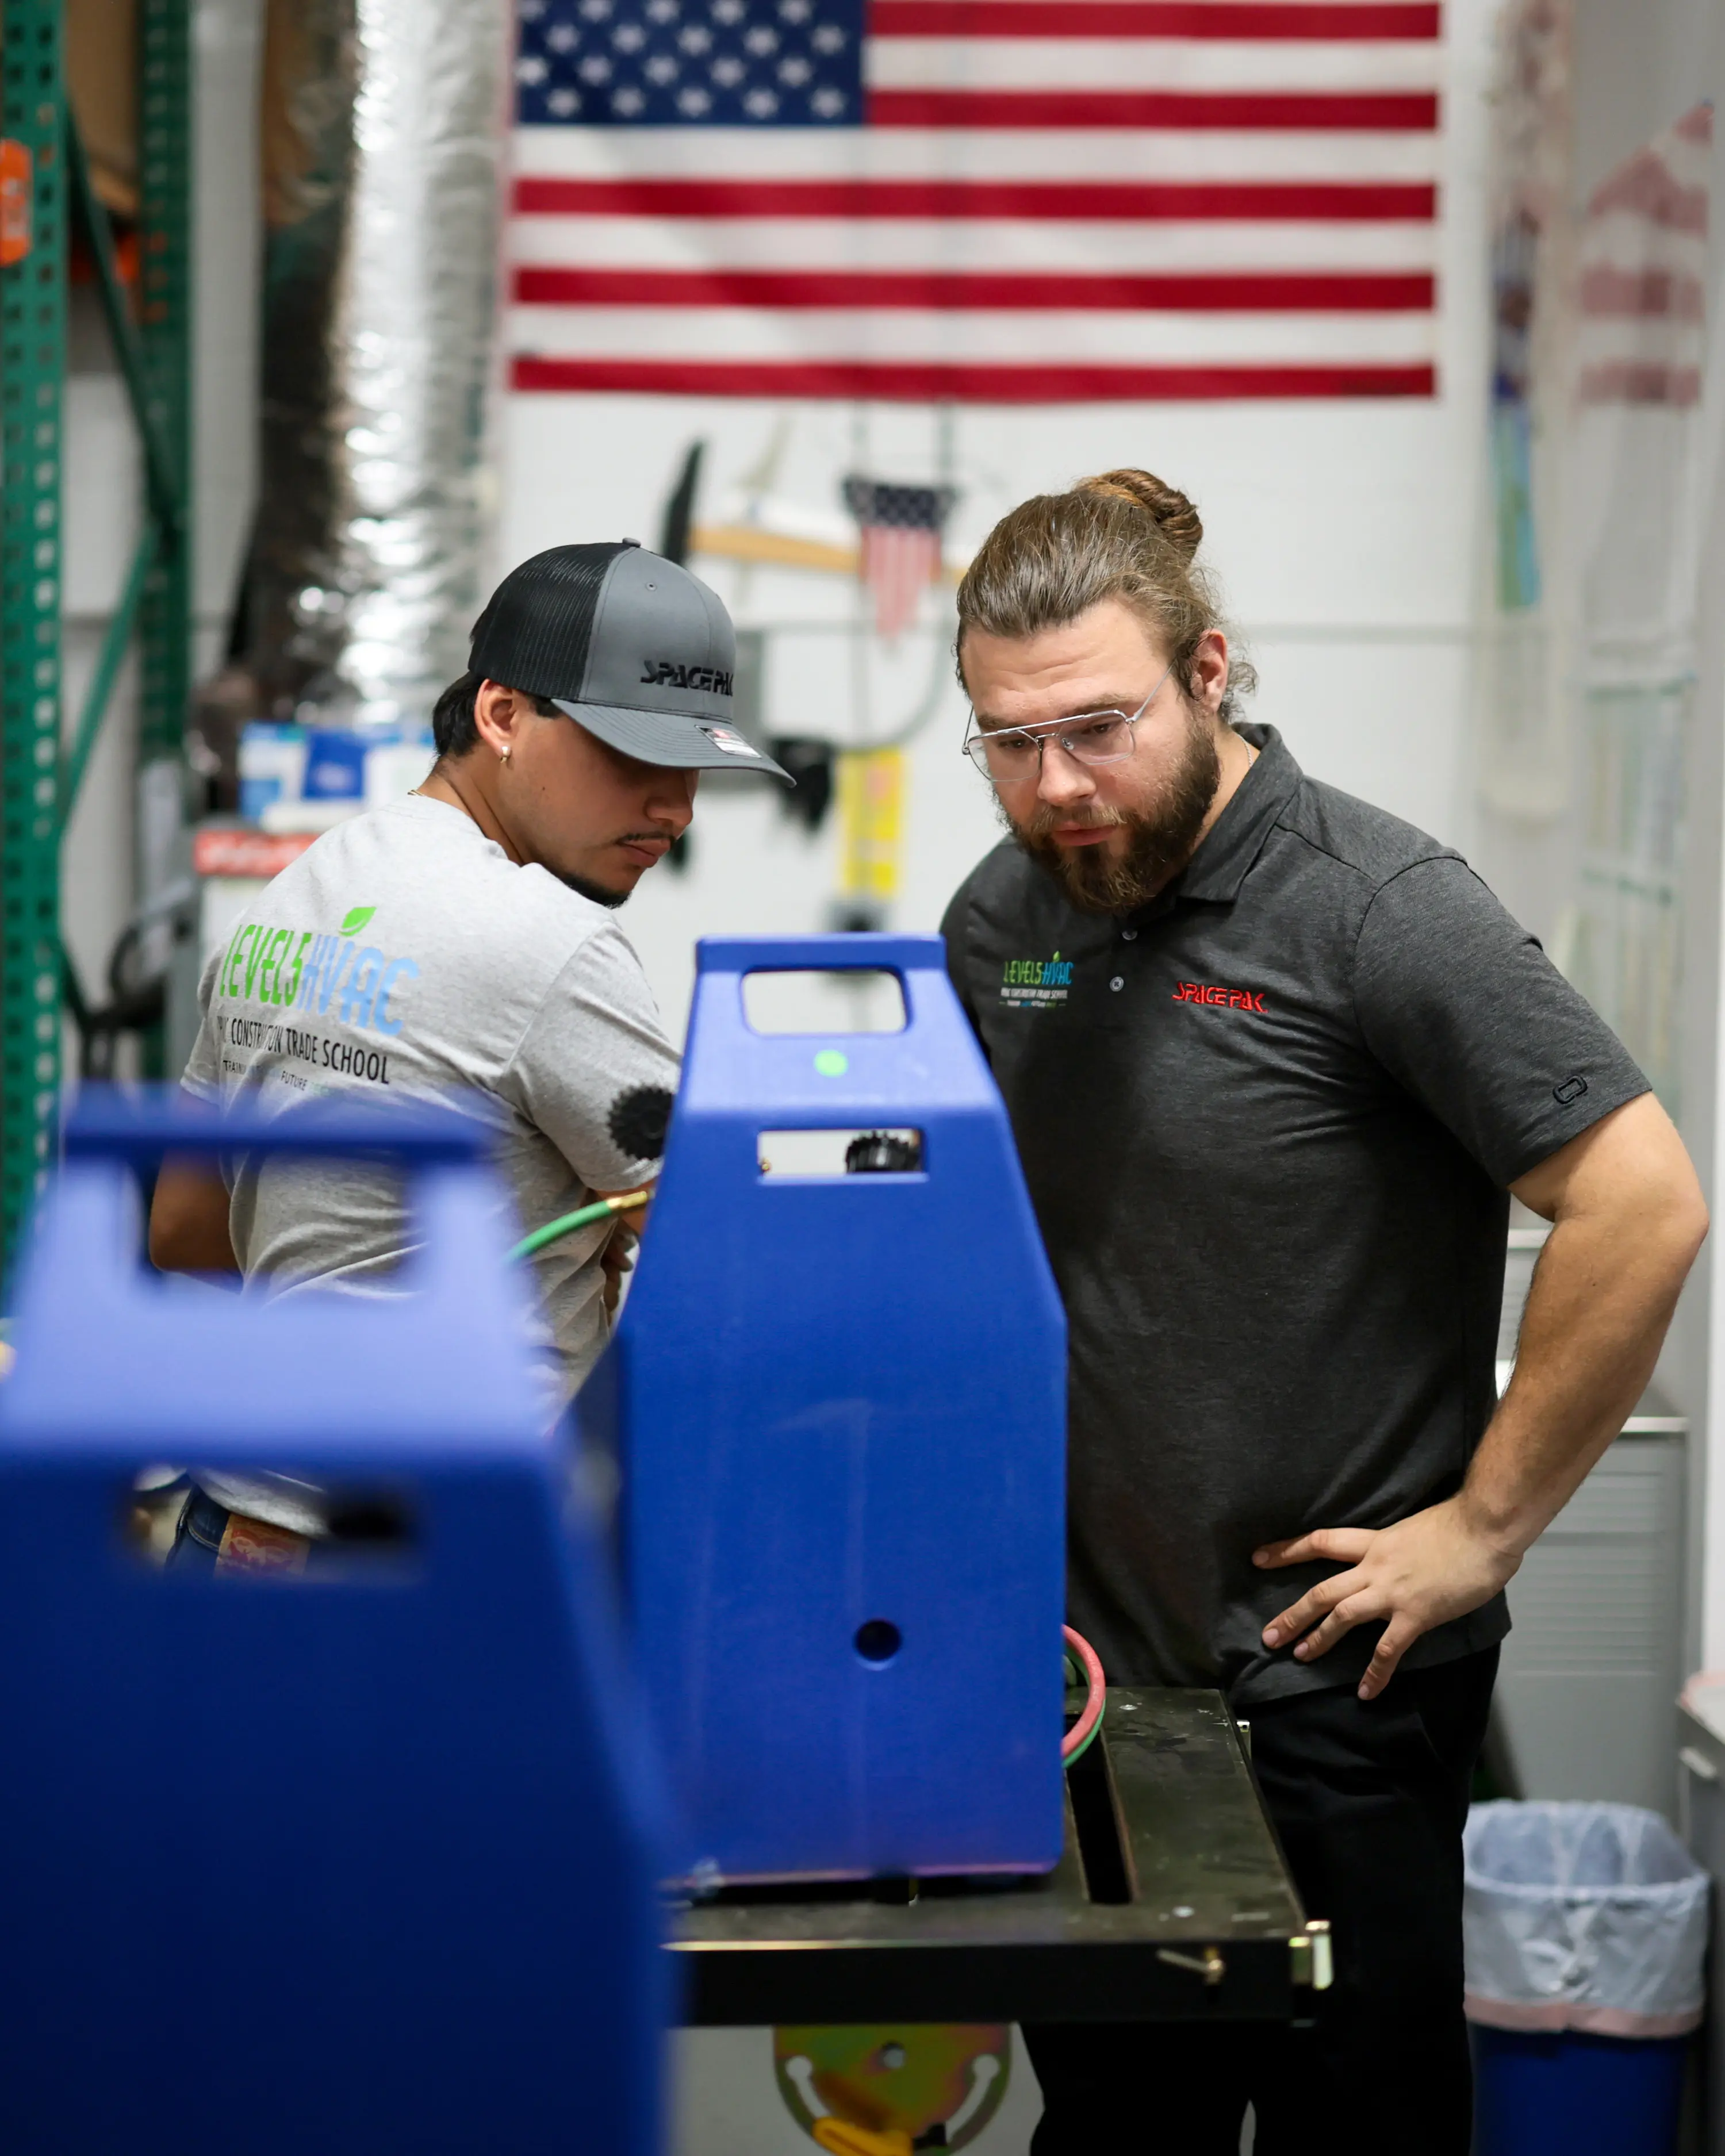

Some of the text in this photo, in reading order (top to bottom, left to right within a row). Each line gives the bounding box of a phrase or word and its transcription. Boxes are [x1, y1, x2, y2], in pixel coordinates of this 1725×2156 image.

[286, 1027, 318, 1064] TRADE
[323, 1039, 390, 1084] SCHOOL
[281, 1071, 308, 1091] FUTURE
